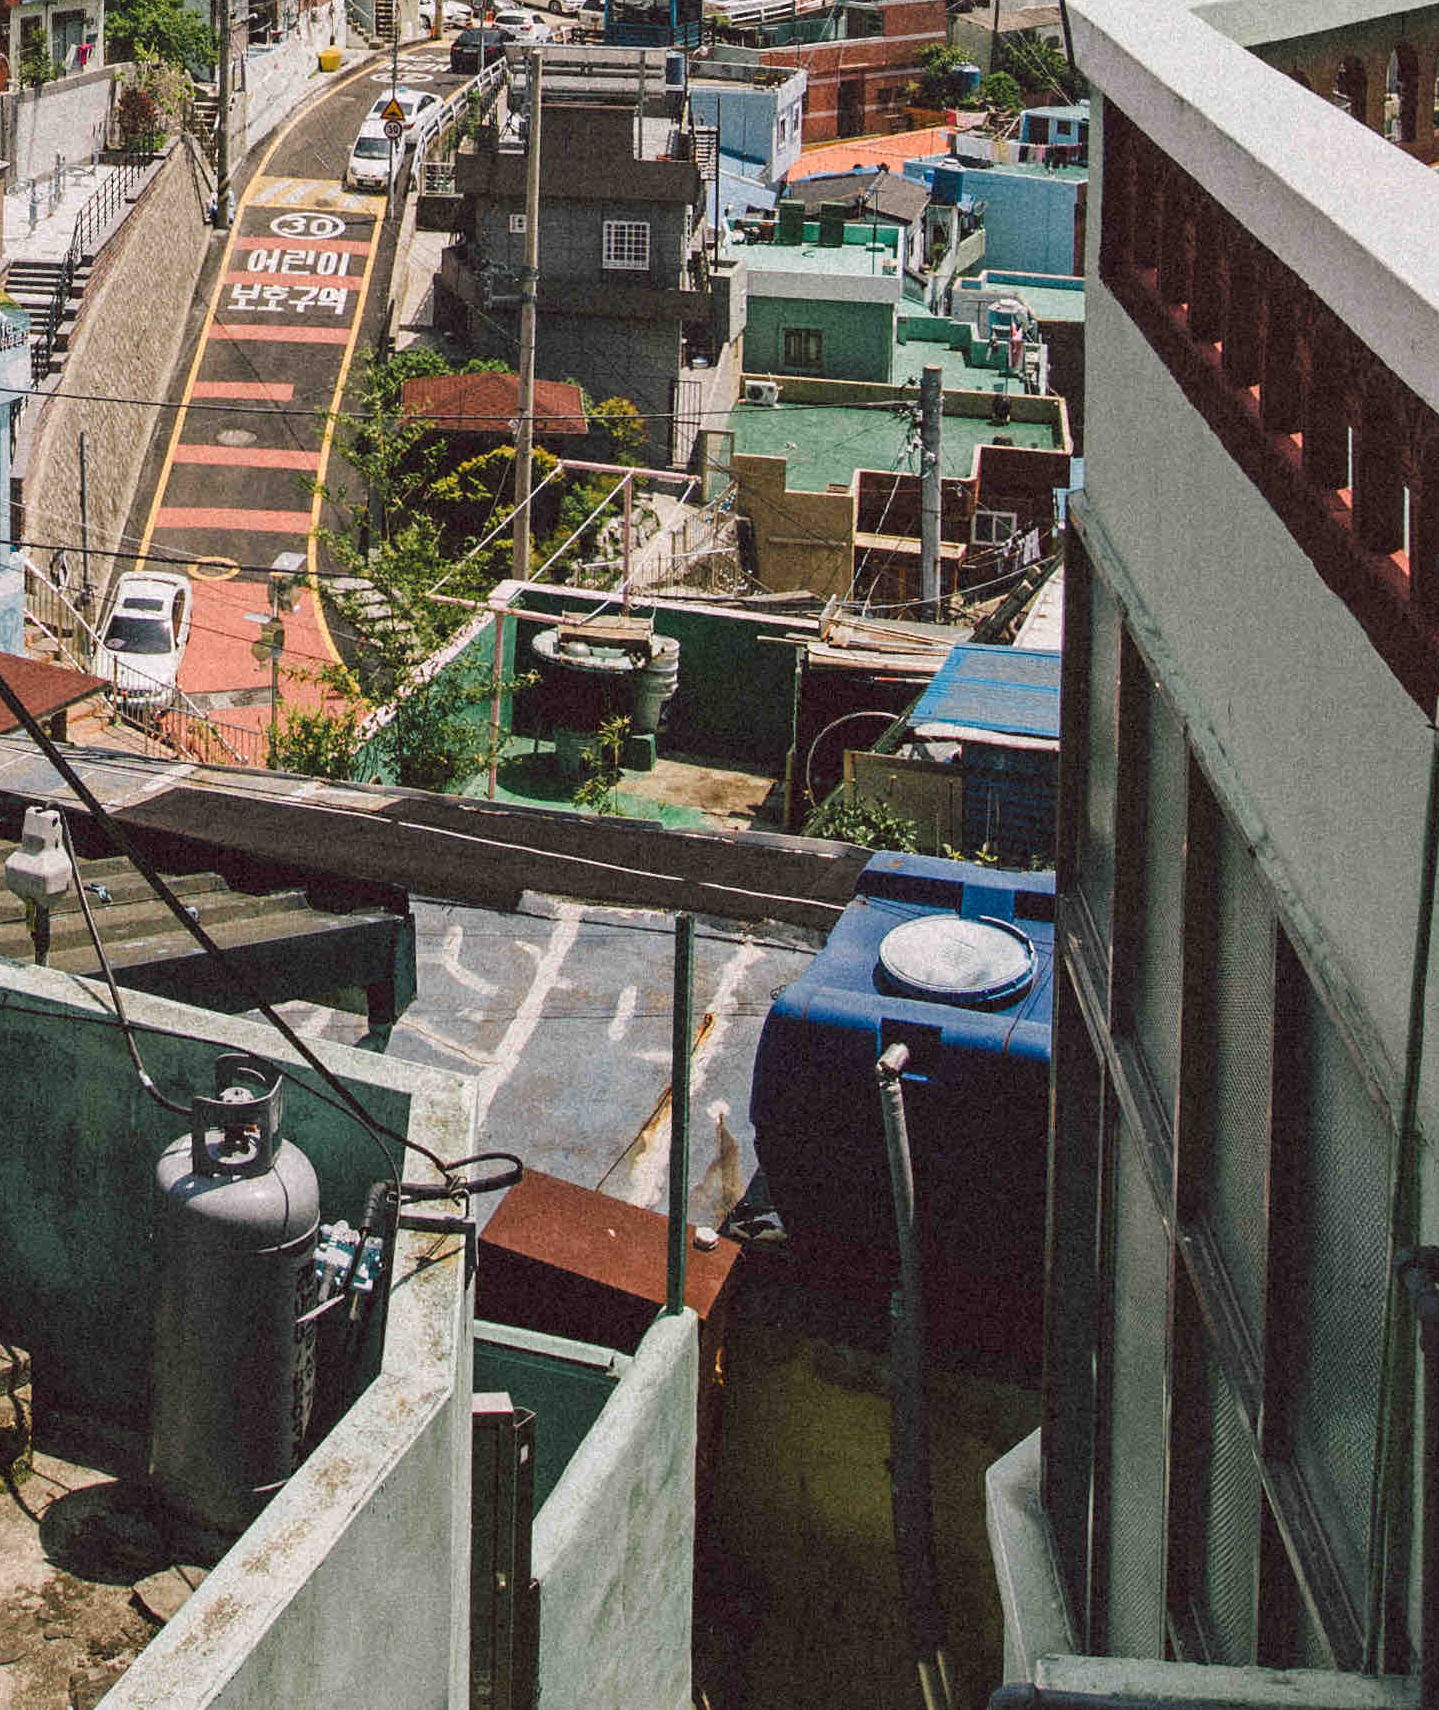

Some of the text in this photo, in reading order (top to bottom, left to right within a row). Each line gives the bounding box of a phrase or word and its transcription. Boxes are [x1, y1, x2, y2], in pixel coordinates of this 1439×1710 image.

[281, 216, 334, 235] 30
[247, 248, 351, 277] 어린이
[227, 282, 348, 315] 보호구역
